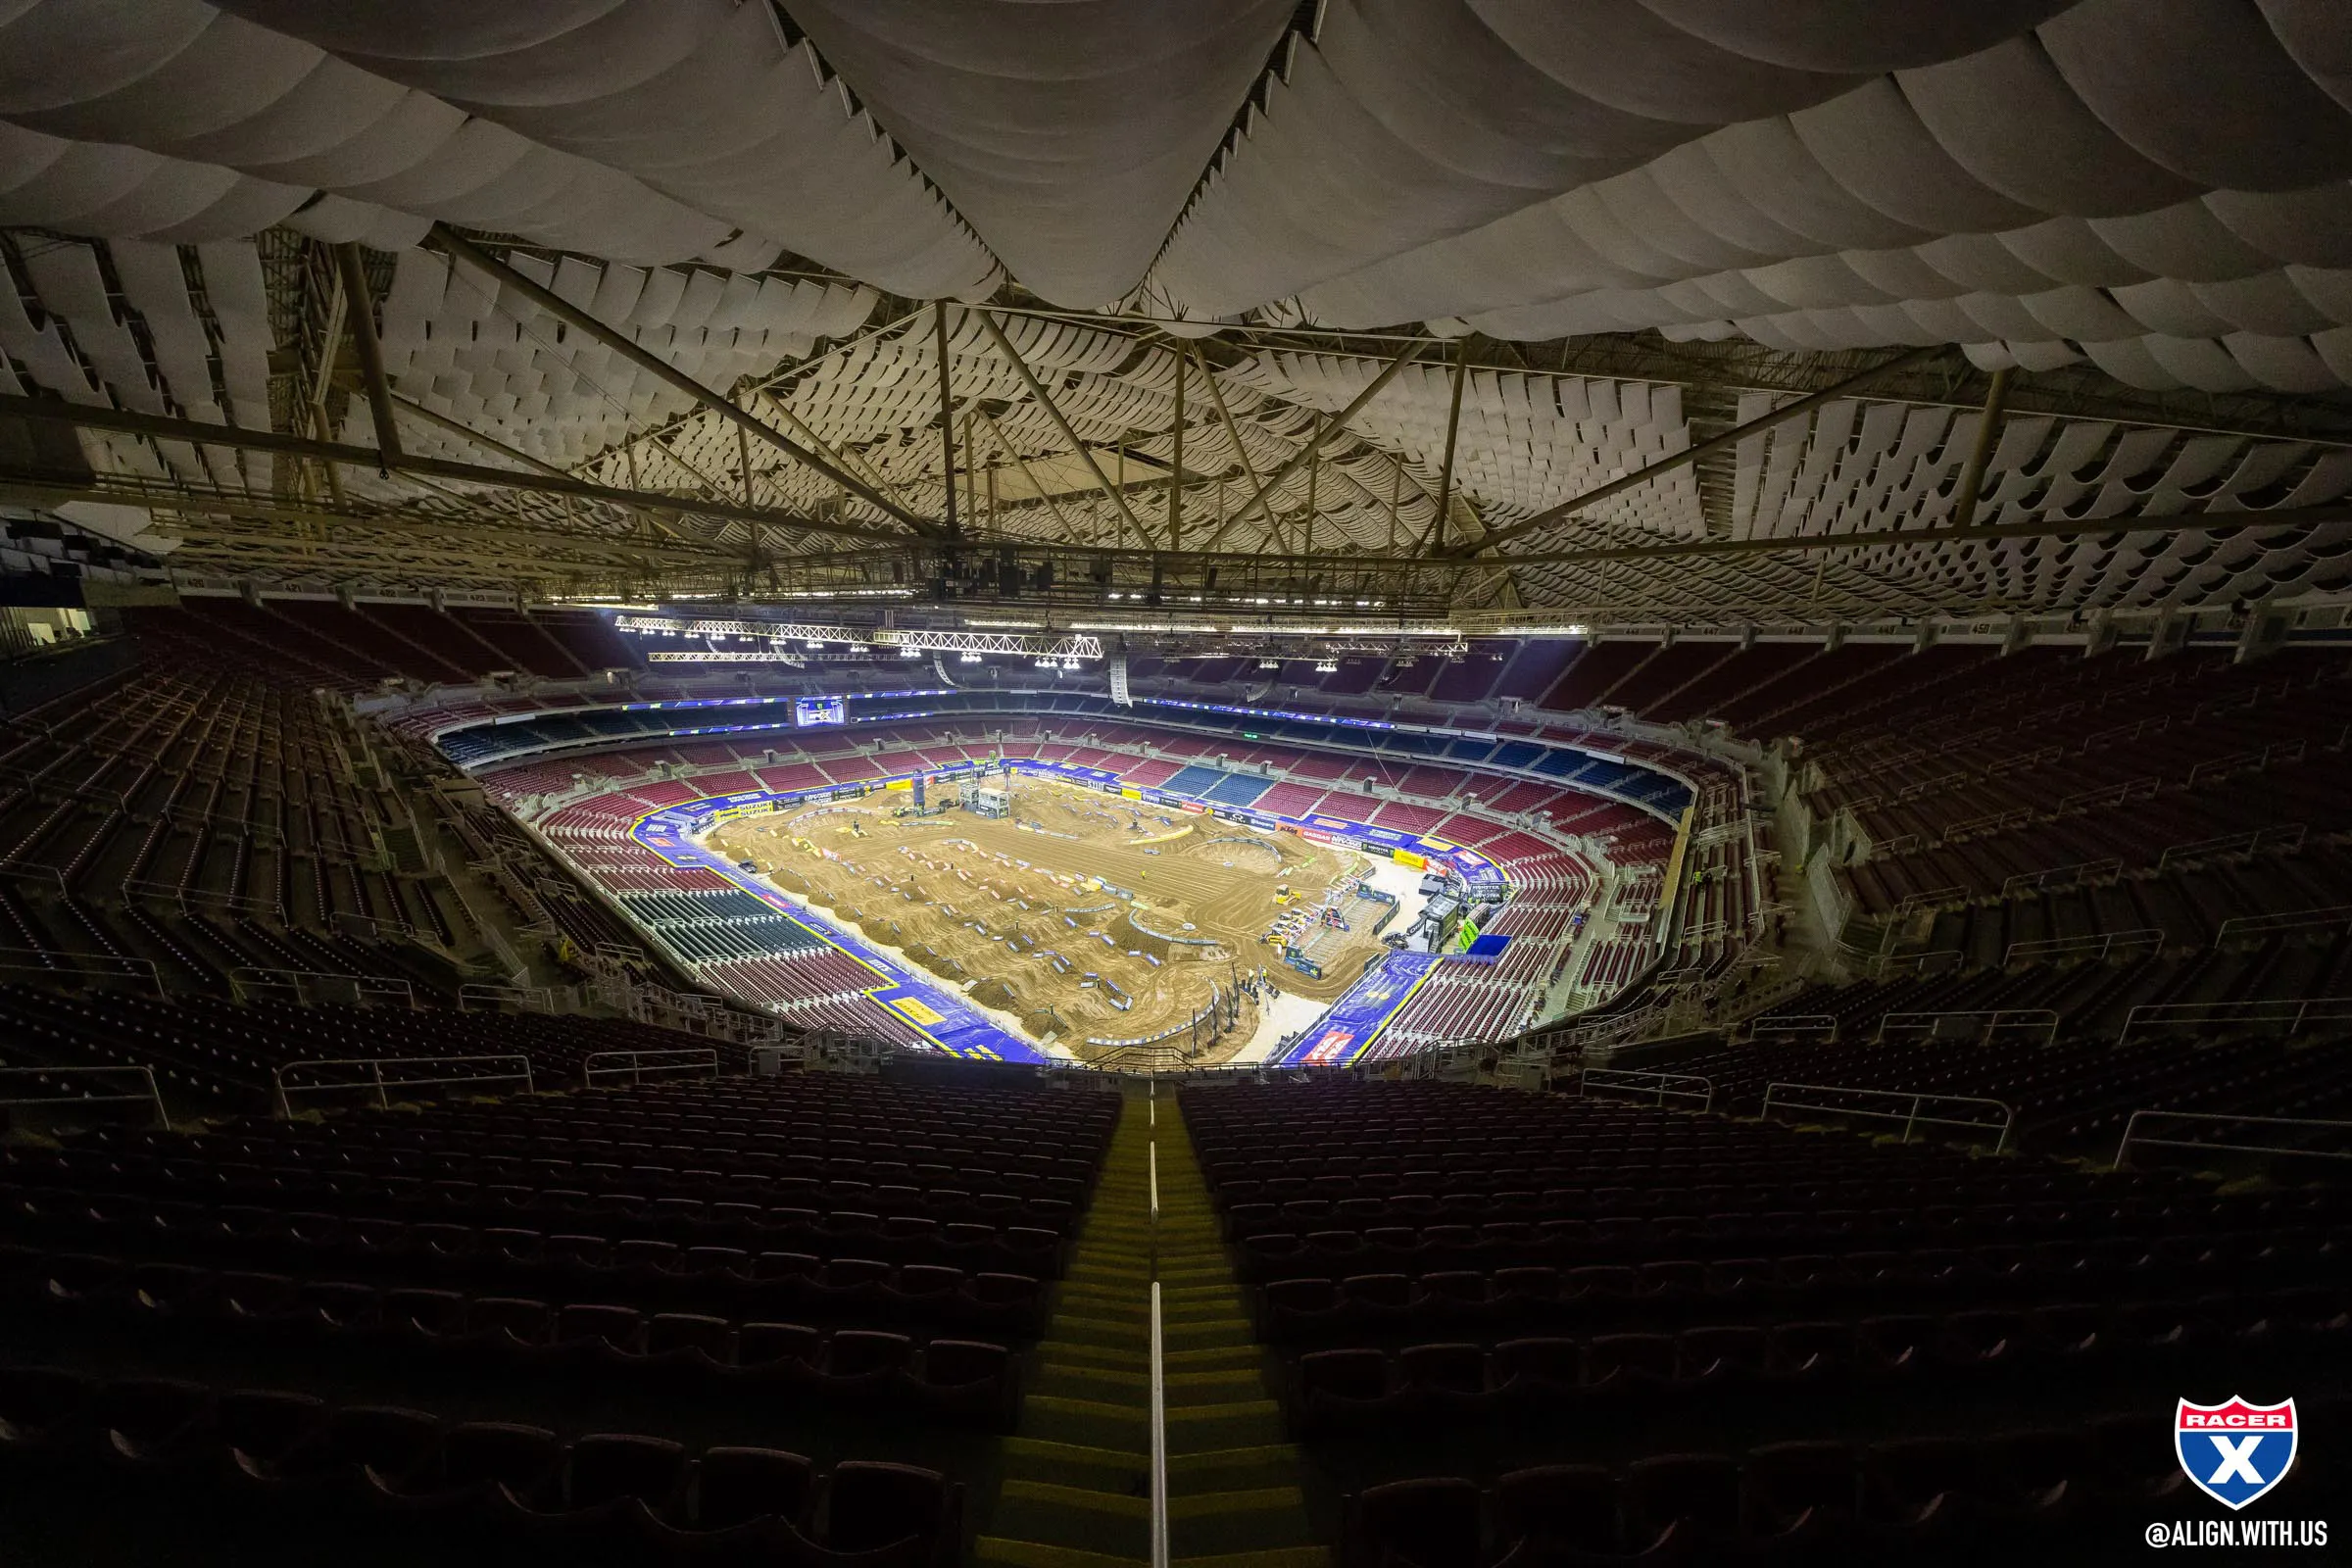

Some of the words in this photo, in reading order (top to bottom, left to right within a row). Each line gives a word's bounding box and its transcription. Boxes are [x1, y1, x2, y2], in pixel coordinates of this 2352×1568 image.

[1973, 624, 1989, 634] 450
[740, 802, 771, 810] SUZUKI
[1303, 831, 1330, 840] GASGAS
